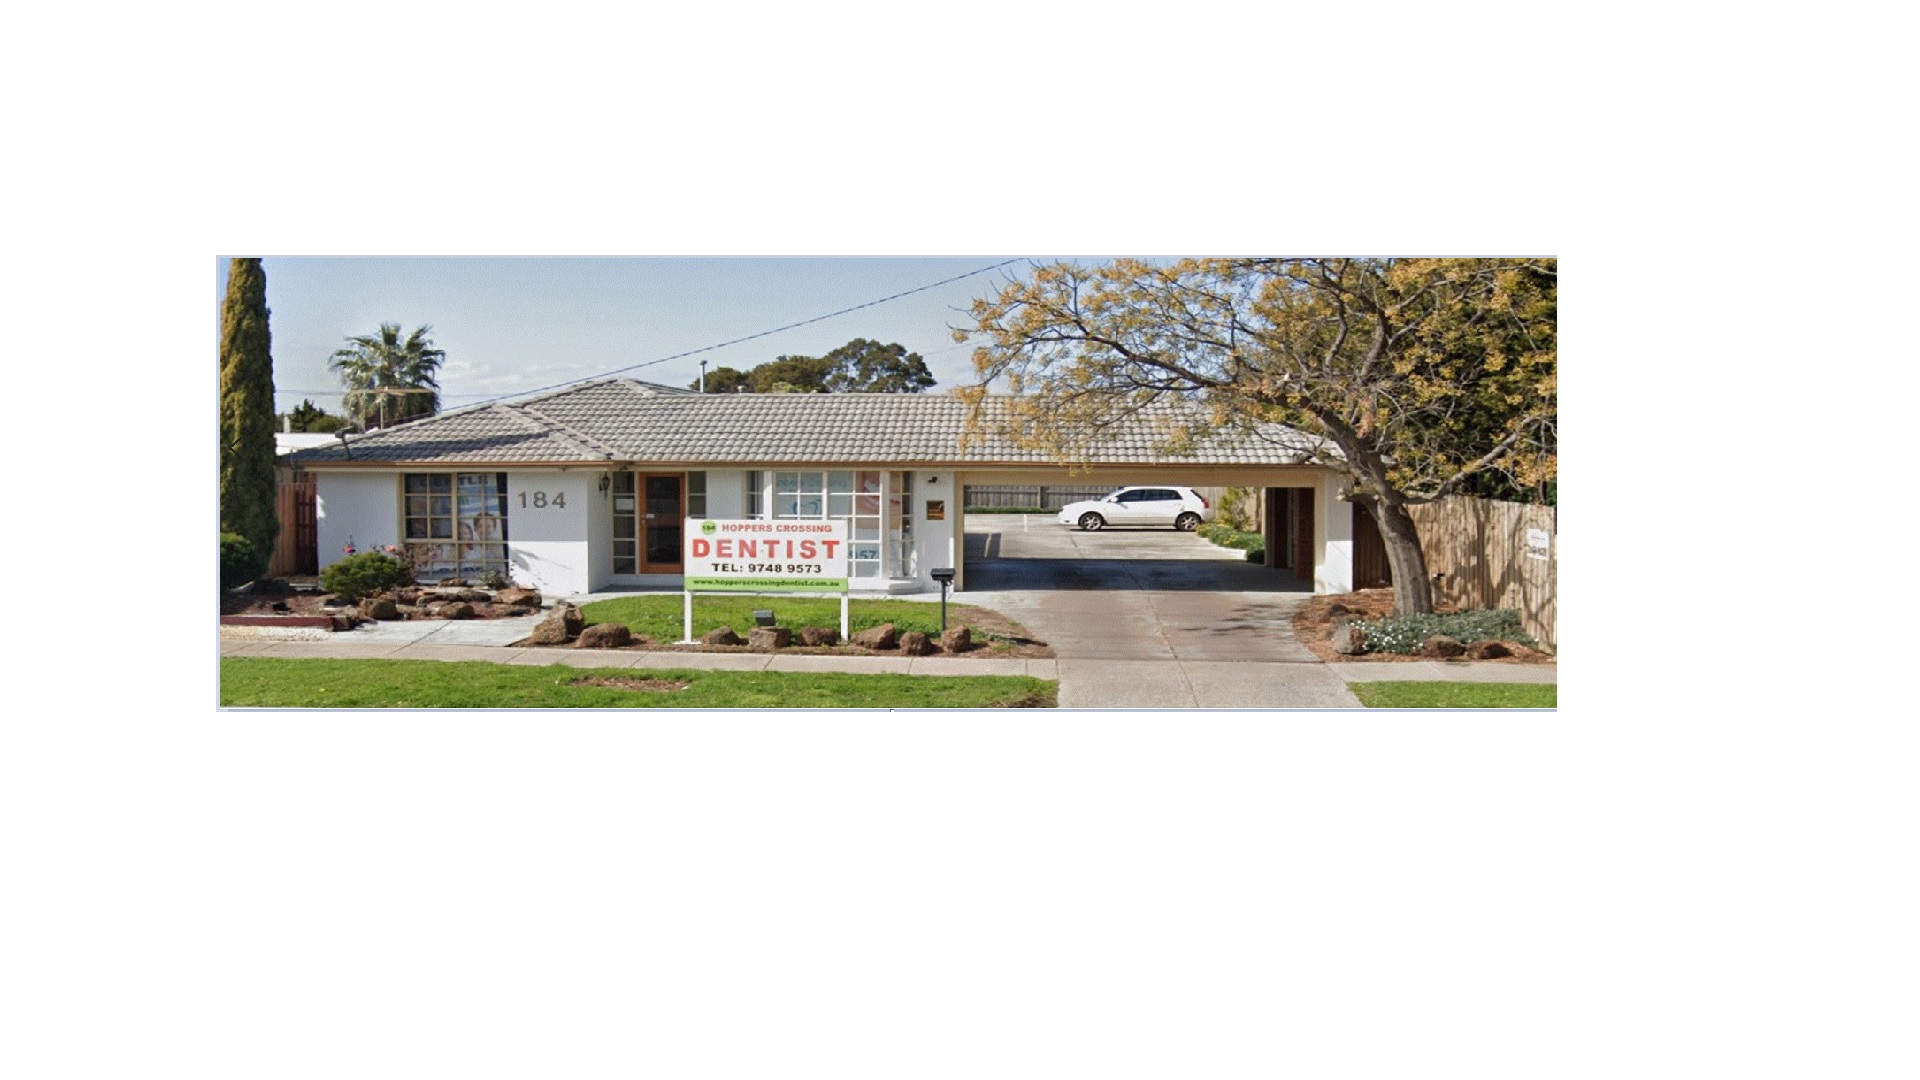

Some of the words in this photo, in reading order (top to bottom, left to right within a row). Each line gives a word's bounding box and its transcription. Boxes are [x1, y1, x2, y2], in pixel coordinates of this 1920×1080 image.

[517, 491, 566, 509] 184
[722, 524, 772, 532] HOPPERS
[776, 524, 833, 533] CROSSING
[692, 539, 840, 559] DENTIST
[712, 563, 743, 572] TEL:
[748, 563, 782, 573] 9748
[787, 564, 822, 573] 9573
[693, 579, 840, 587] www.hopperscrossingdentist.com.au
